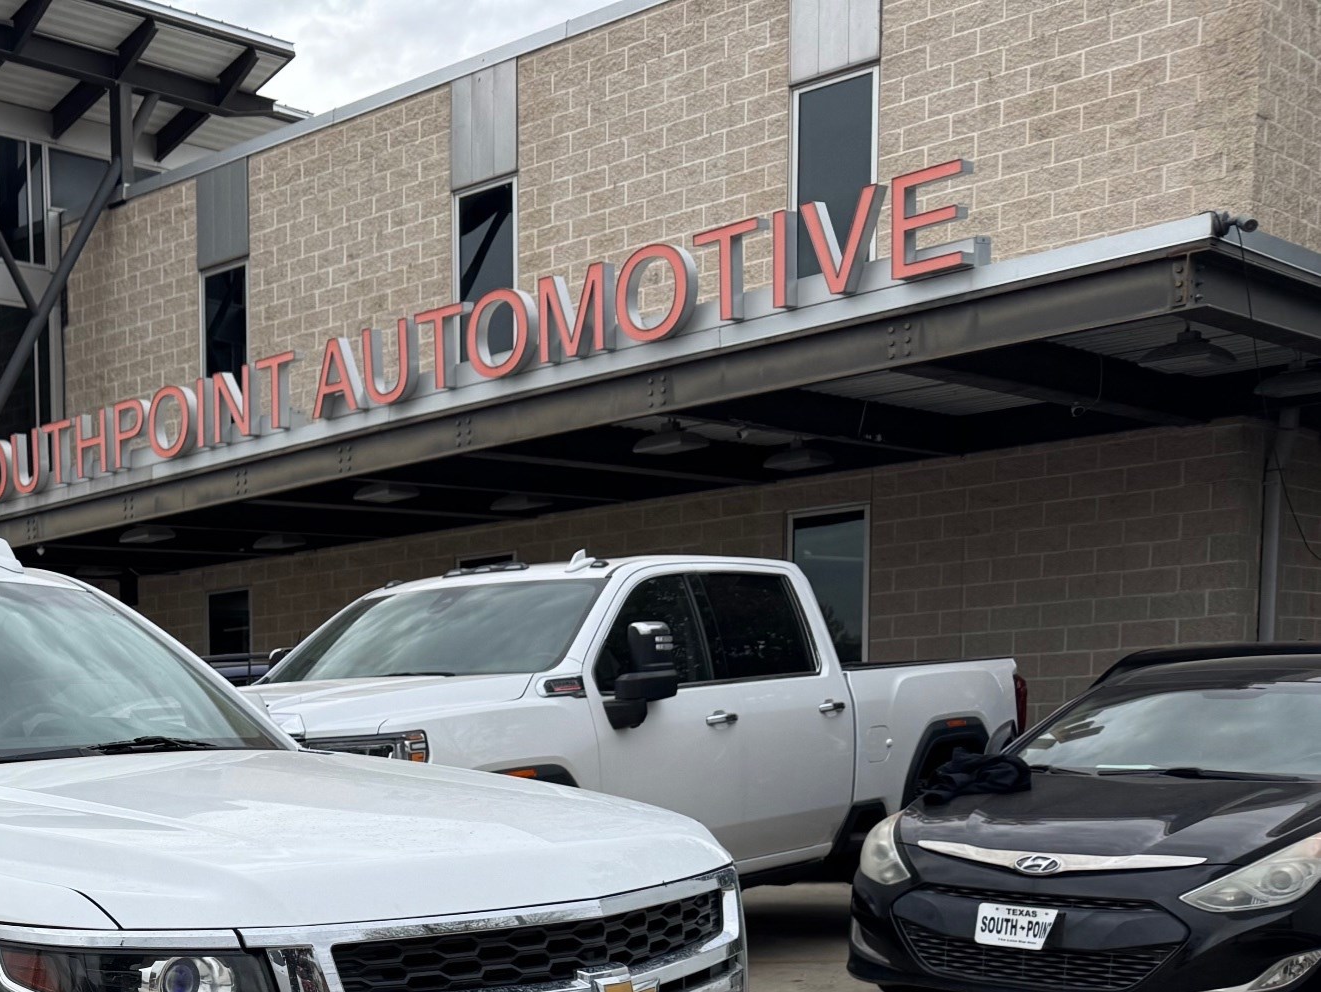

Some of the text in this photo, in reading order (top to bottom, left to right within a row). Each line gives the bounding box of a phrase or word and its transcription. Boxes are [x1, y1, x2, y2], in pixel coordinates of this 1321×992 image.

[313, 159, 971, 420] AUTOMOTIVE
[1006, 907, 1038, 918] TEXAS
[980, 915, 1018, 936] SOUTH
